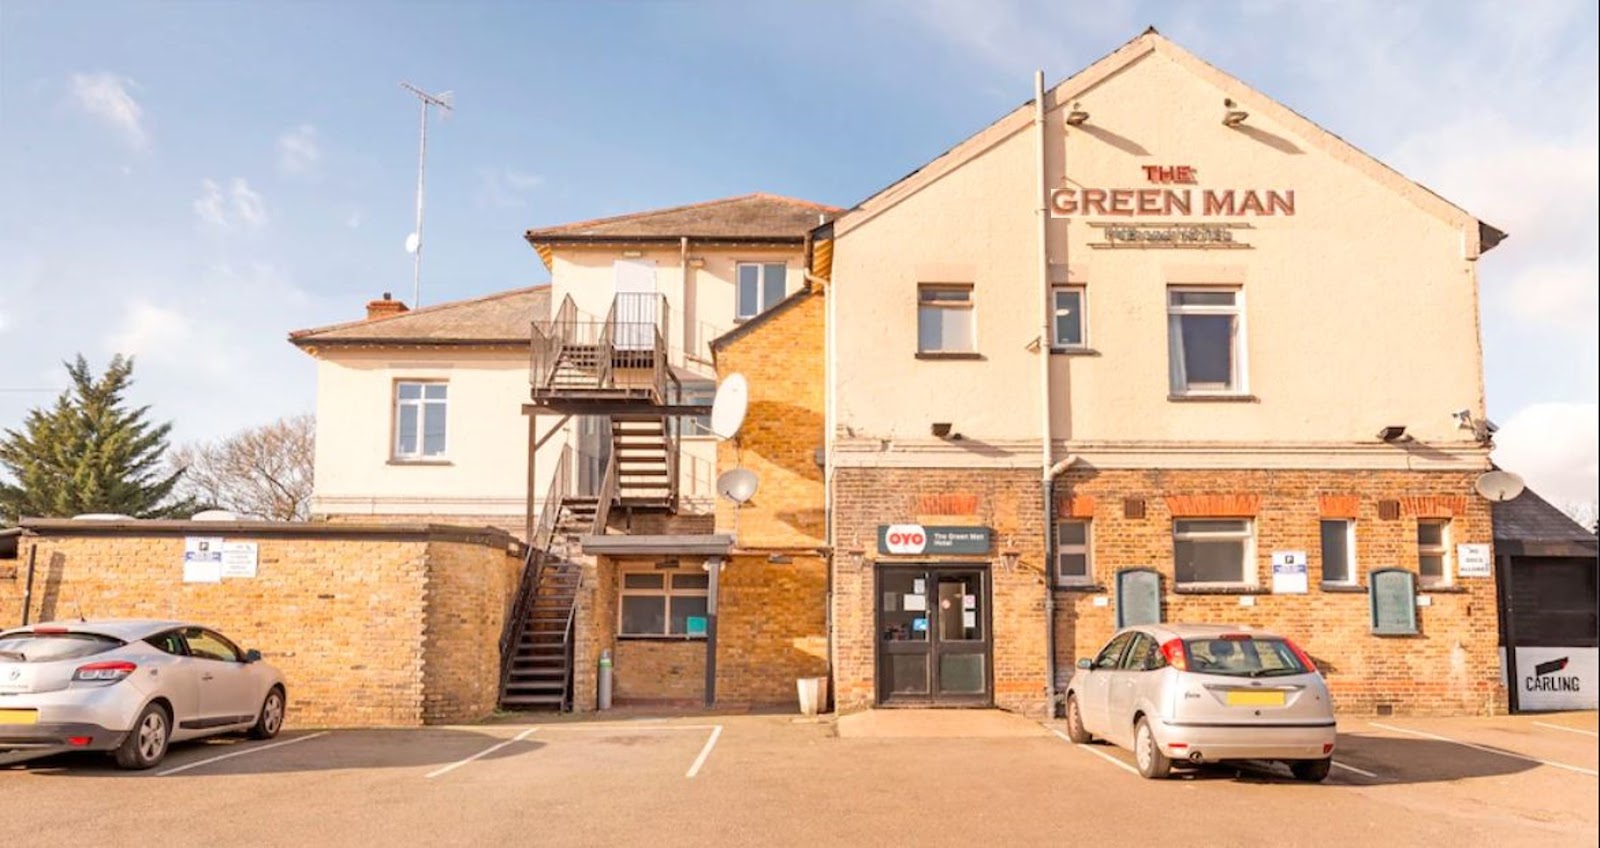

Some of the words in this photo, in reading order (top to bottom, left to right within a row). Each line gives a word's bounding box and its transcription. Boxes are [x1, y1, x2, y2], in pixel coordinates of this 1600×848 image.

[1142, 165, 1197, 184] THE
[1052, 189, 1192, 216] GREEN
[1203, 190, 1295, 216] MAN
[889, 533, 924, 545] OYO
[1526, 676, 1580, 692] CARLING
